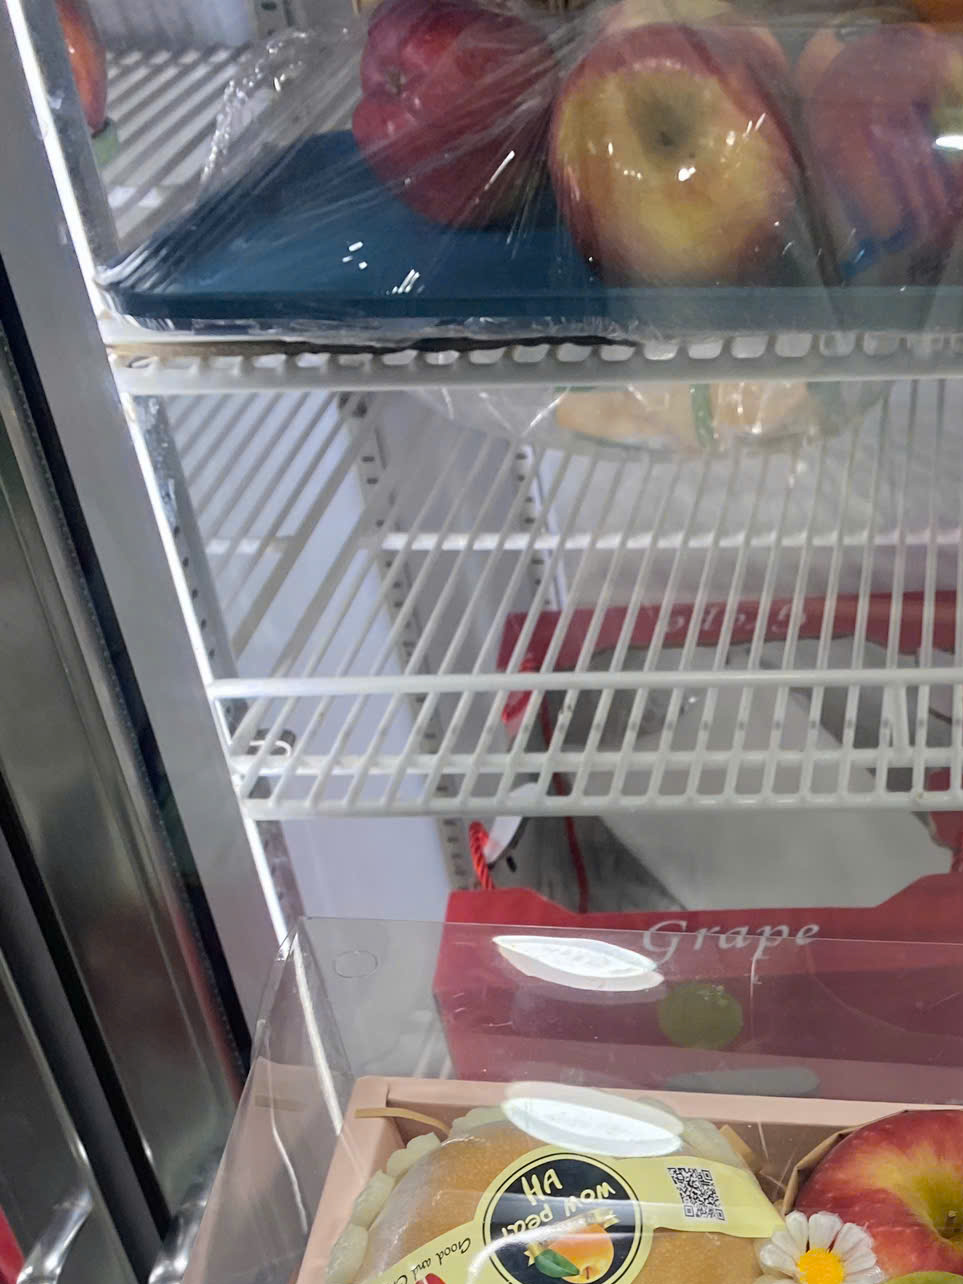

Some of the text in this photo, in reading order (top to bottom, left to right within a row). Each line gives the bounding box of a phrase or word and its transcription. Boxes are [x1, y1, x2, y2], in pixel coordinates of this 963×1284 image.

[643, 919, 821, 966] Grape
[436, 1237, 471, 1265] Good
[411, 1258, 431, 1281] and
